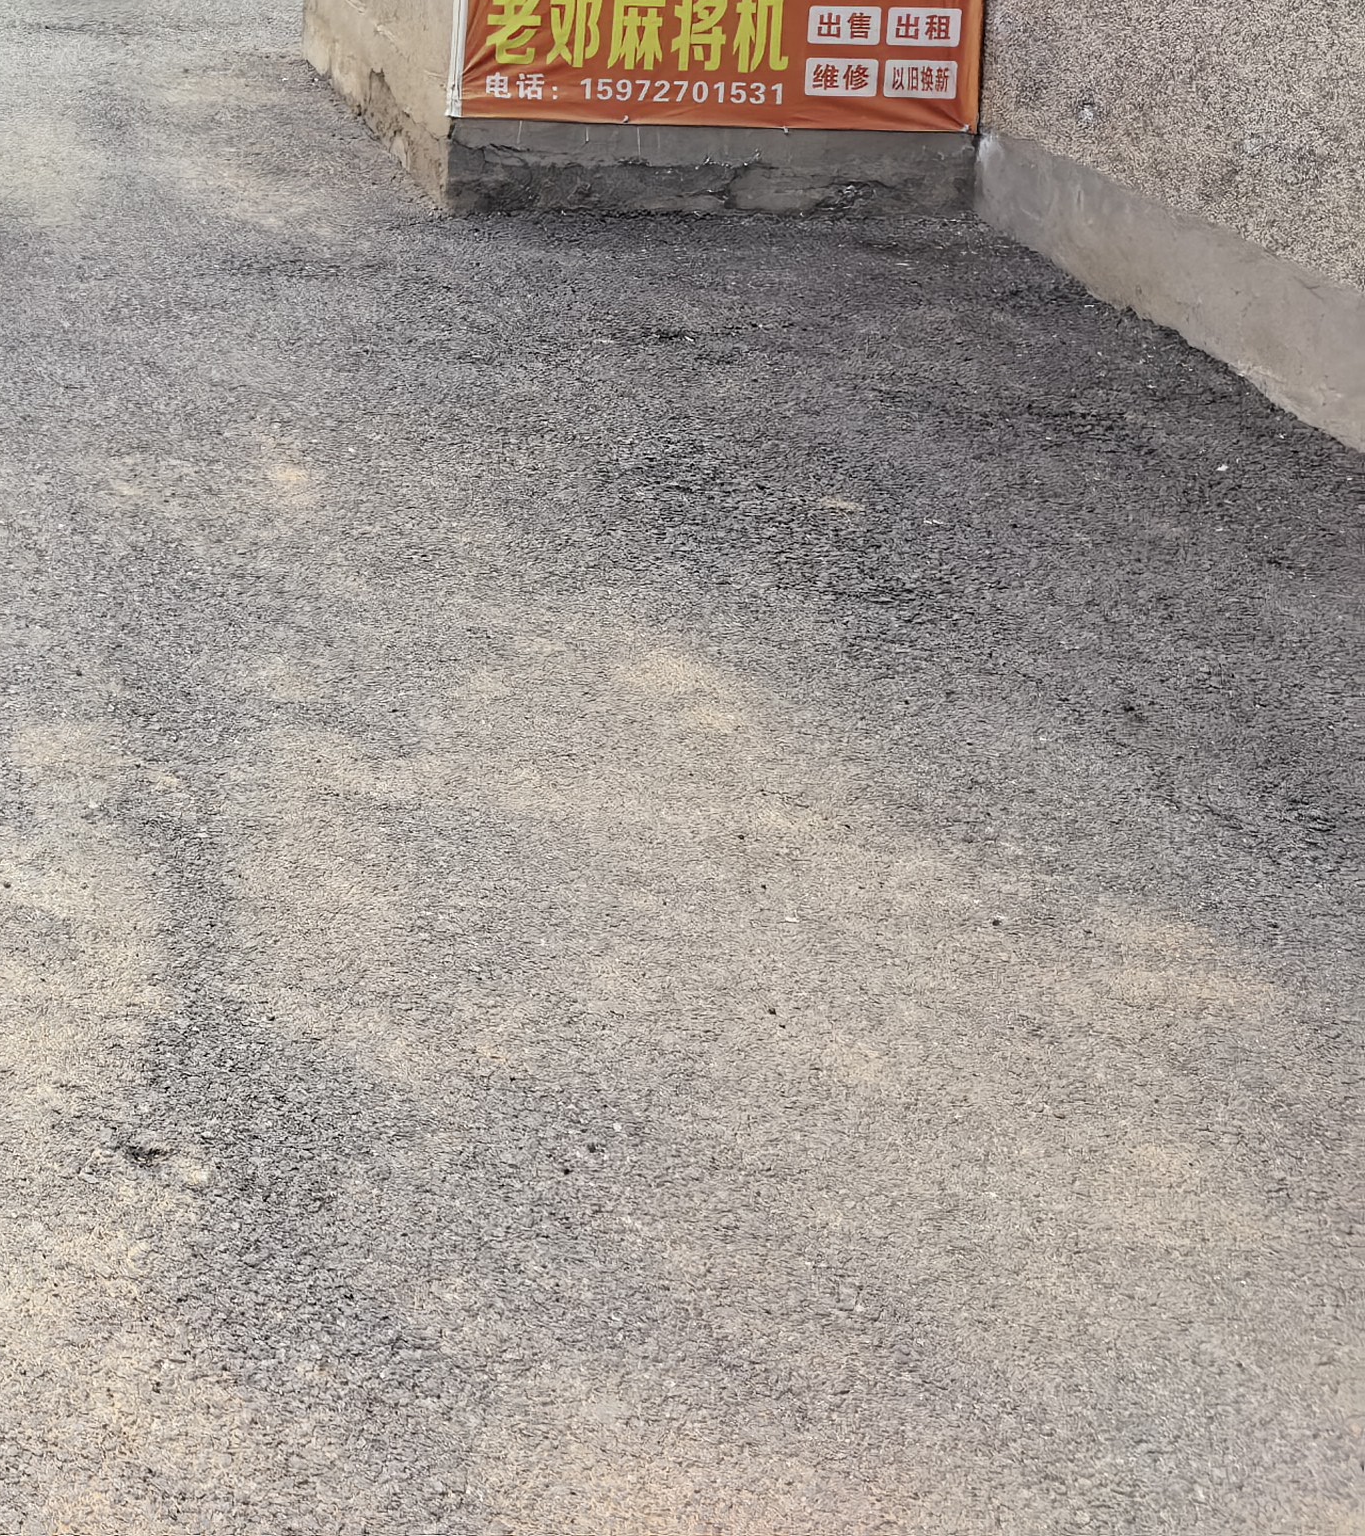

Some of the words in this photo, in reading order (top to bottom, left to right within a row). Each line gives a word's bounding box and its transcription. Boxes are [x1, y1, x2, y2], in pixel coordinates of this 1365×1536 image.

[817, 12, 871, 39] 出售
[895, 13, 951, 40] 出租
[812, 64, 869, 90] 维修
[892, 66, 950, 92] 以旧换新
